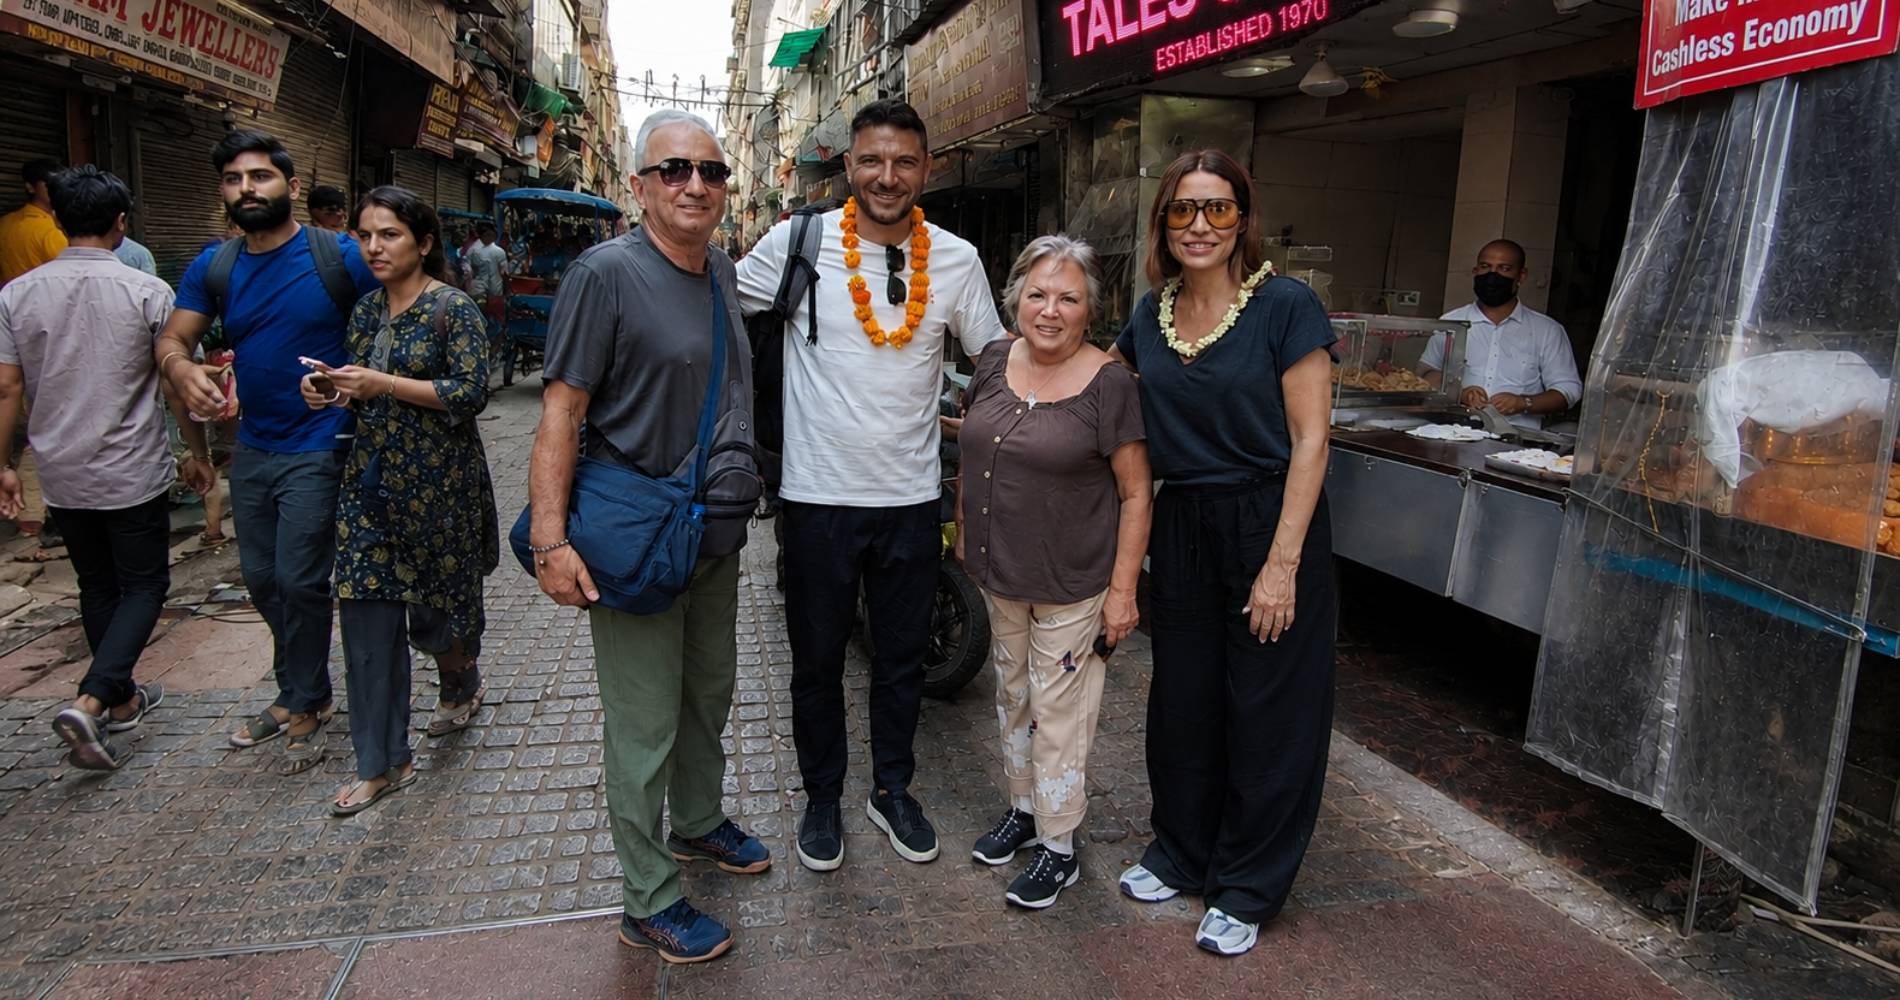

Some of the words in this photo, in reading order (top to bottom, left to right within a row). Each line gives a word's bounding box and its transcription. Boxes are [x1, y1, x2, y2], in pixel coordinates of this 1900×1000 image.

[141, 0, 280, 80] JEWELLERS
[1155, 12, 1273, 71] ESTABLISHED
[1278, 0, 1328, 31] 1970
[1652, 31, 1736, 76] Cashless
[1743, 0, 1868, 51] Economy
